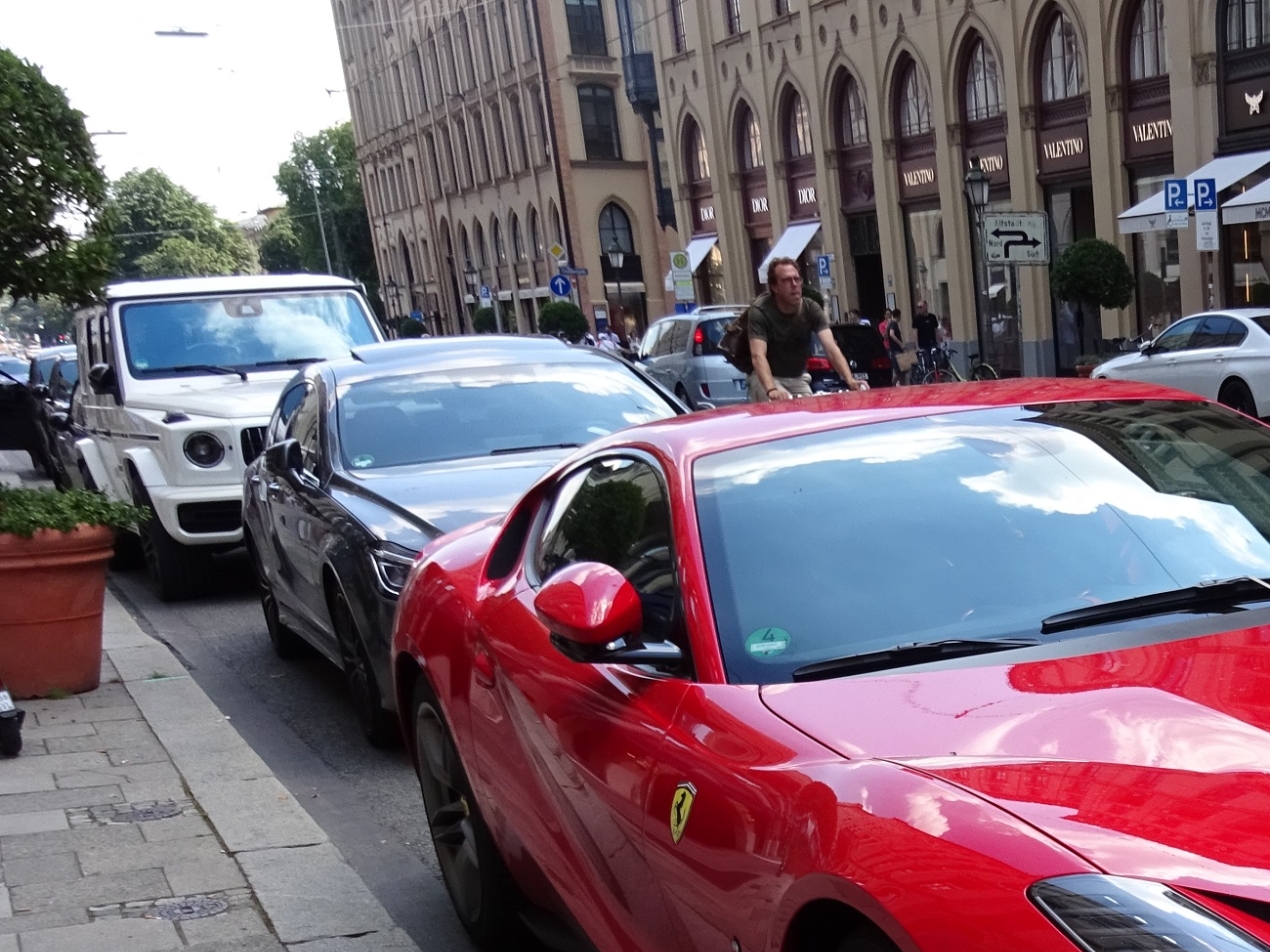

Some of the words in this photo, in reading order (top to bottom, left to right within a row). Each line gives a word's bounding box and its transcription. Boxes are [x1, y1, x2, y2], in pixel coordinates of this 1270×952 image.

[1132, 119, 1173, 142] VALENTIN
[1043, 138, 1084, 159] VALENTINO
[903, 168, 935, 186] VALENTINO
[798, 187, 816, 204] DIOR
[1168, 183, 1180, 207] P
[1197, 183, 1209, 207] P
[700, 206, 715, 221] DIOR
[751, 197, 769, 213] DIOR
[1255, 206, 1270, 219] MCM
